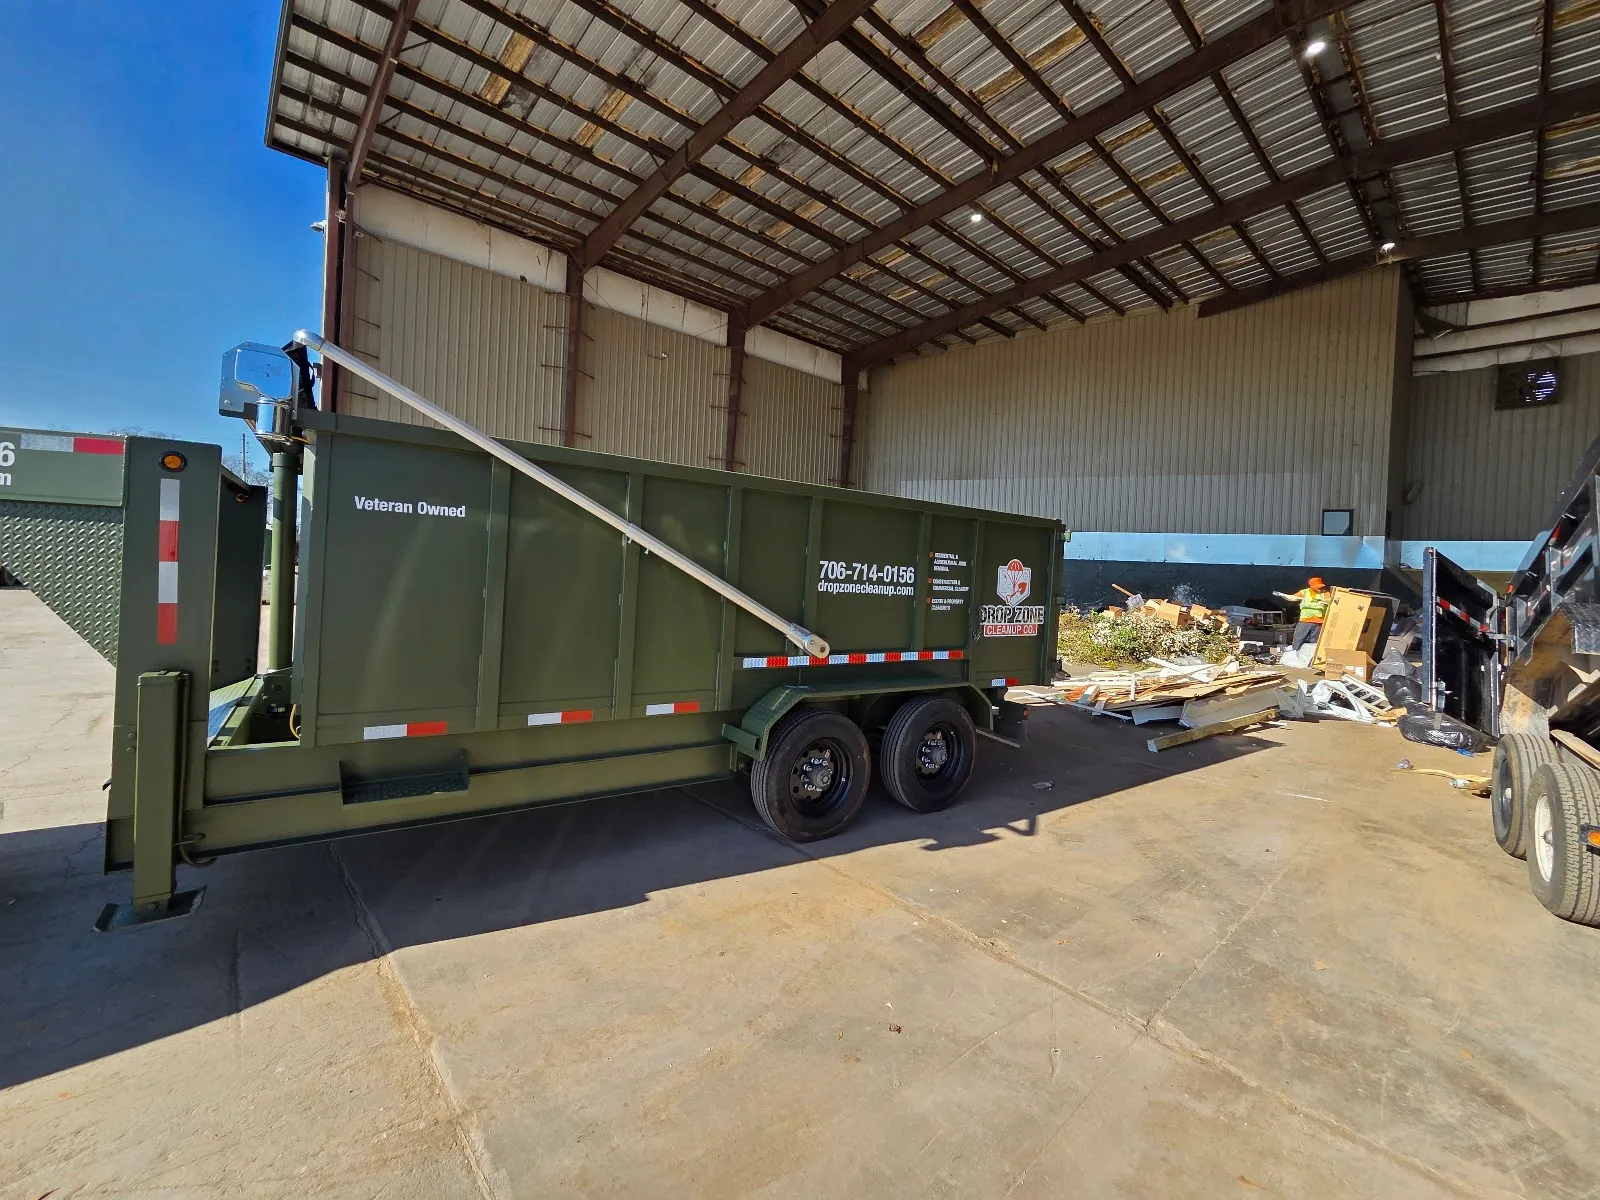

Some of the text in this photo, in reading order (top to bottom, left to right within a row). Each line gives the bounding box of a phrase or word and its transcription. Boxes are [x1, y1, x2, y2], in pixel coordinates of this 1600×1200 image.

[354, 495, 466, 518] Veteran Owned
[819, 560, 915, 584] 706-714-0156
[817, 580, 914, 597] dropzonecleanup.com
[979, 604, 1045, 625] DROP ZONE
[986, 624, 1035, 635] CLEANUP CO.
